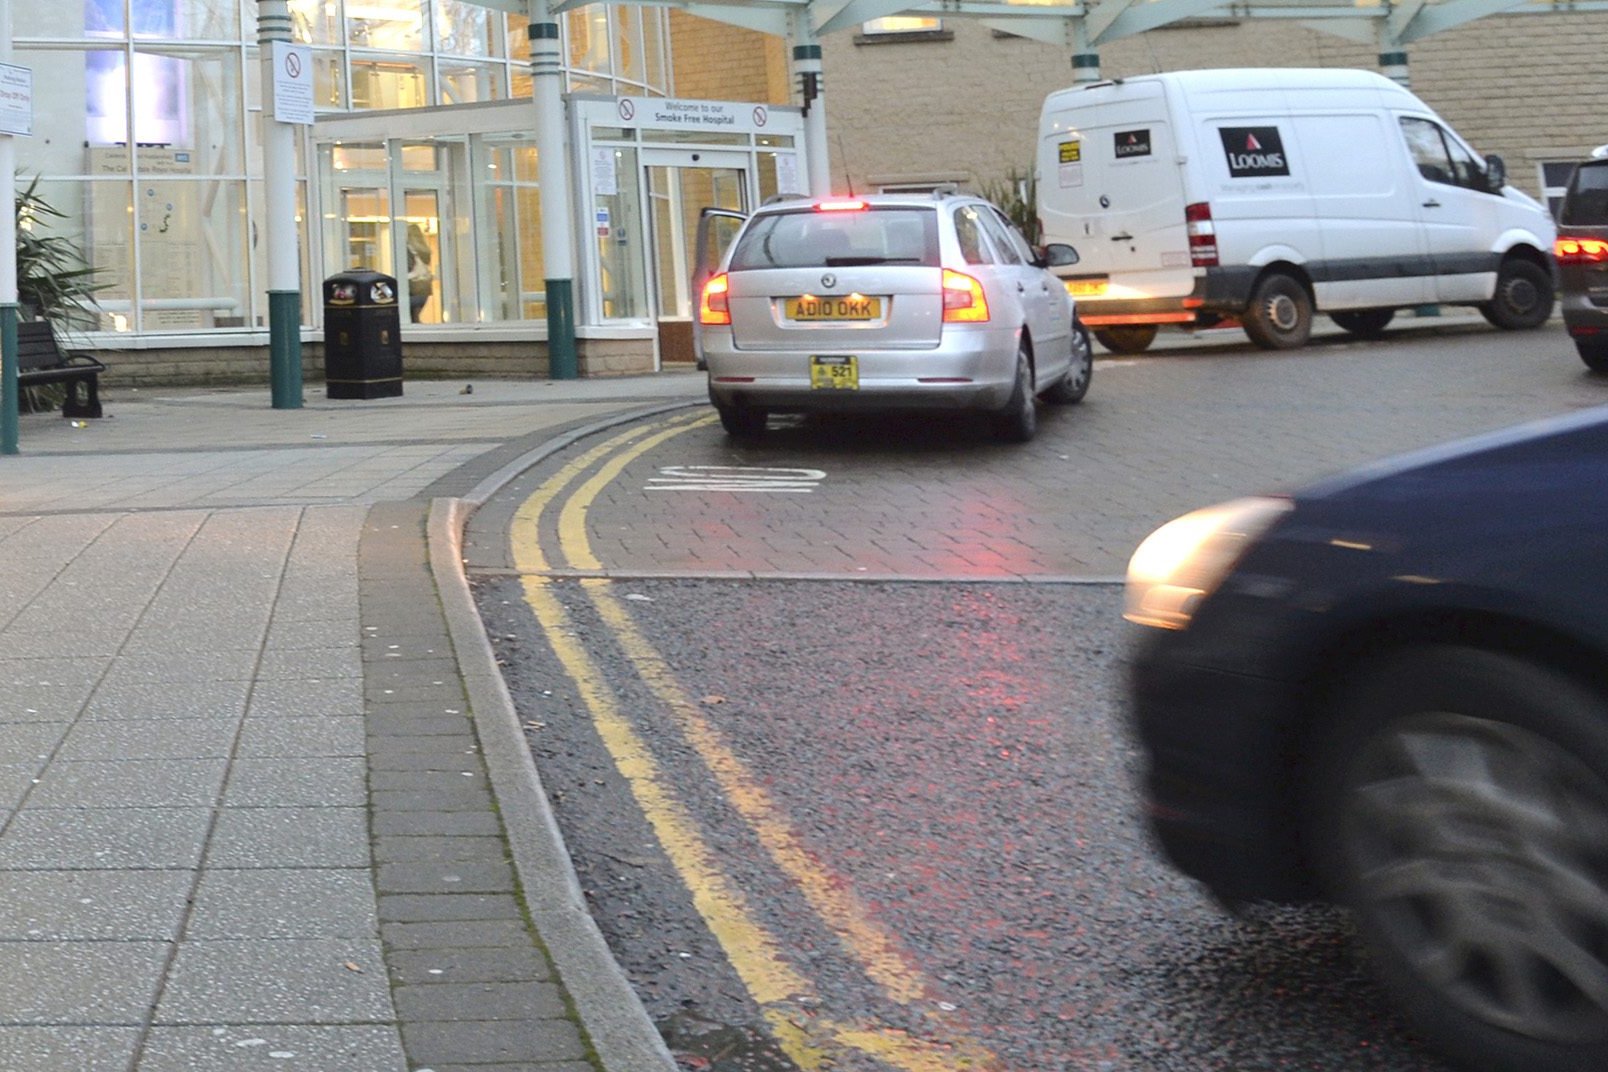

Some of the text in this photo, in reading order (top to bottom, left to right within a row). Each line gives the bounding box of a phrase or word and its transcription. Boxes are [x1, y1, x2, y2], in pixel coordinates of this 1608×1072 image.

[665, 101, 723, 113] Welcome to our
[655, 112, 735, 126] Smoke Free Hospital
[1228, 152, 1284, 170] LOOMIS
[796, 301, 872, 316] AD10 OKK
[832, 366, 852, 377] 521
